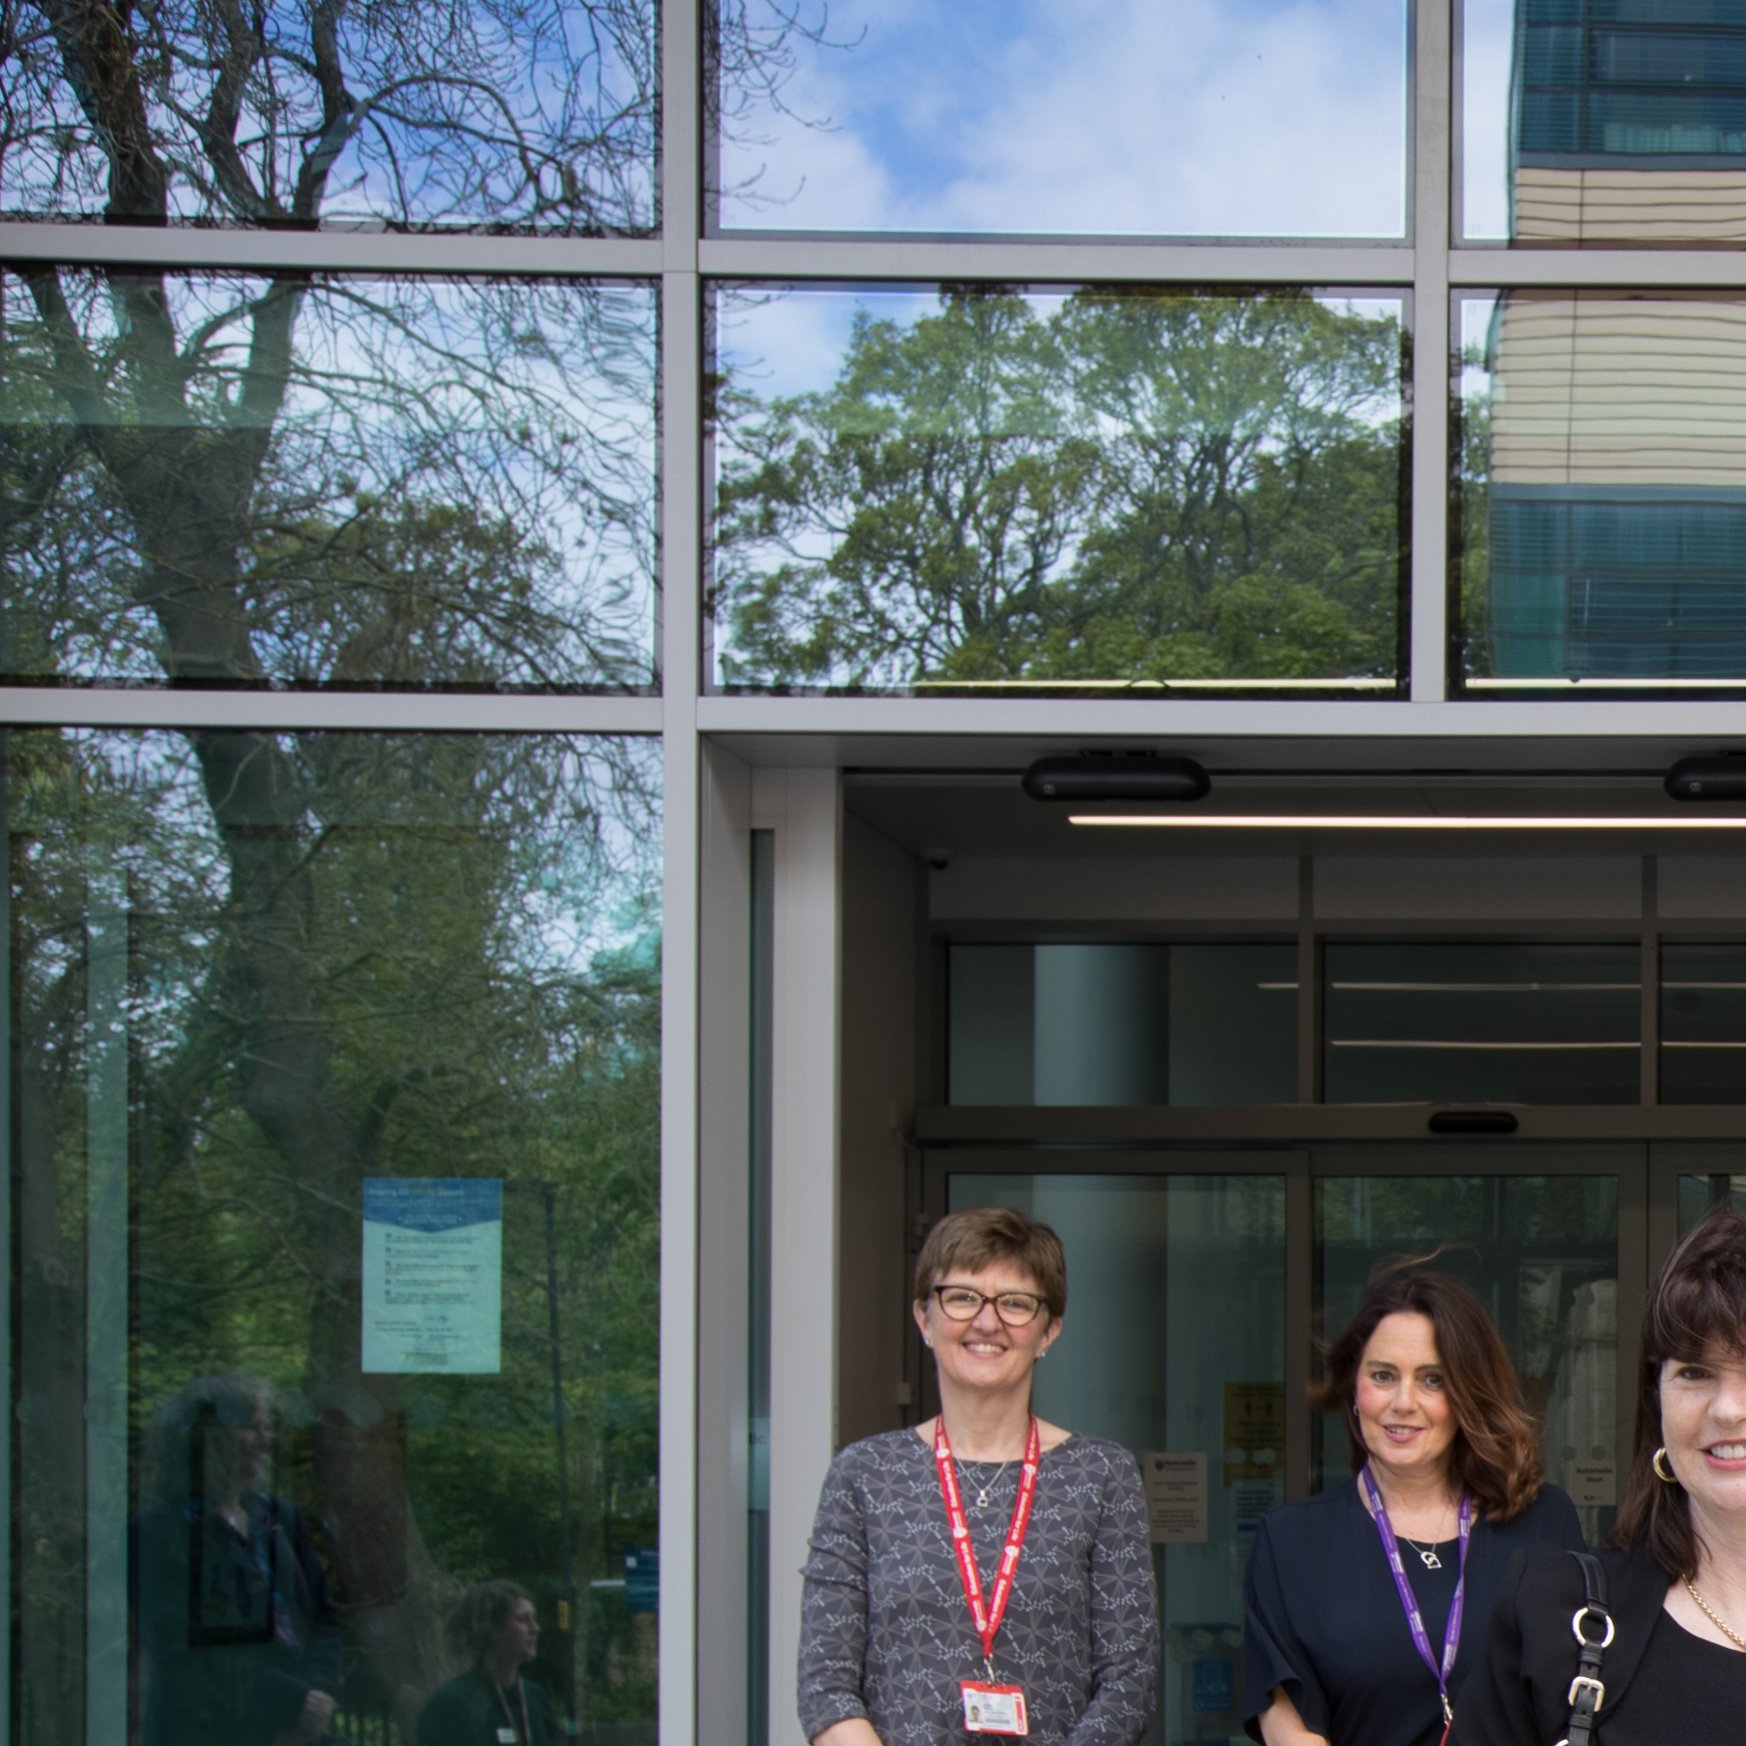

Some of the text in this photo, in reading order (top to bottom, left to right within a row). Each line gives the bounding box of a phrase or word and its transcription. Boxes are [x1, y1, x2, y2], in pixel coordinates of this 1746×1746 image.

[959, 1541, 968, 1554] Life
[963, 1562, 978, 1595] Education
[990, 1579, 1006, 1613] Education
